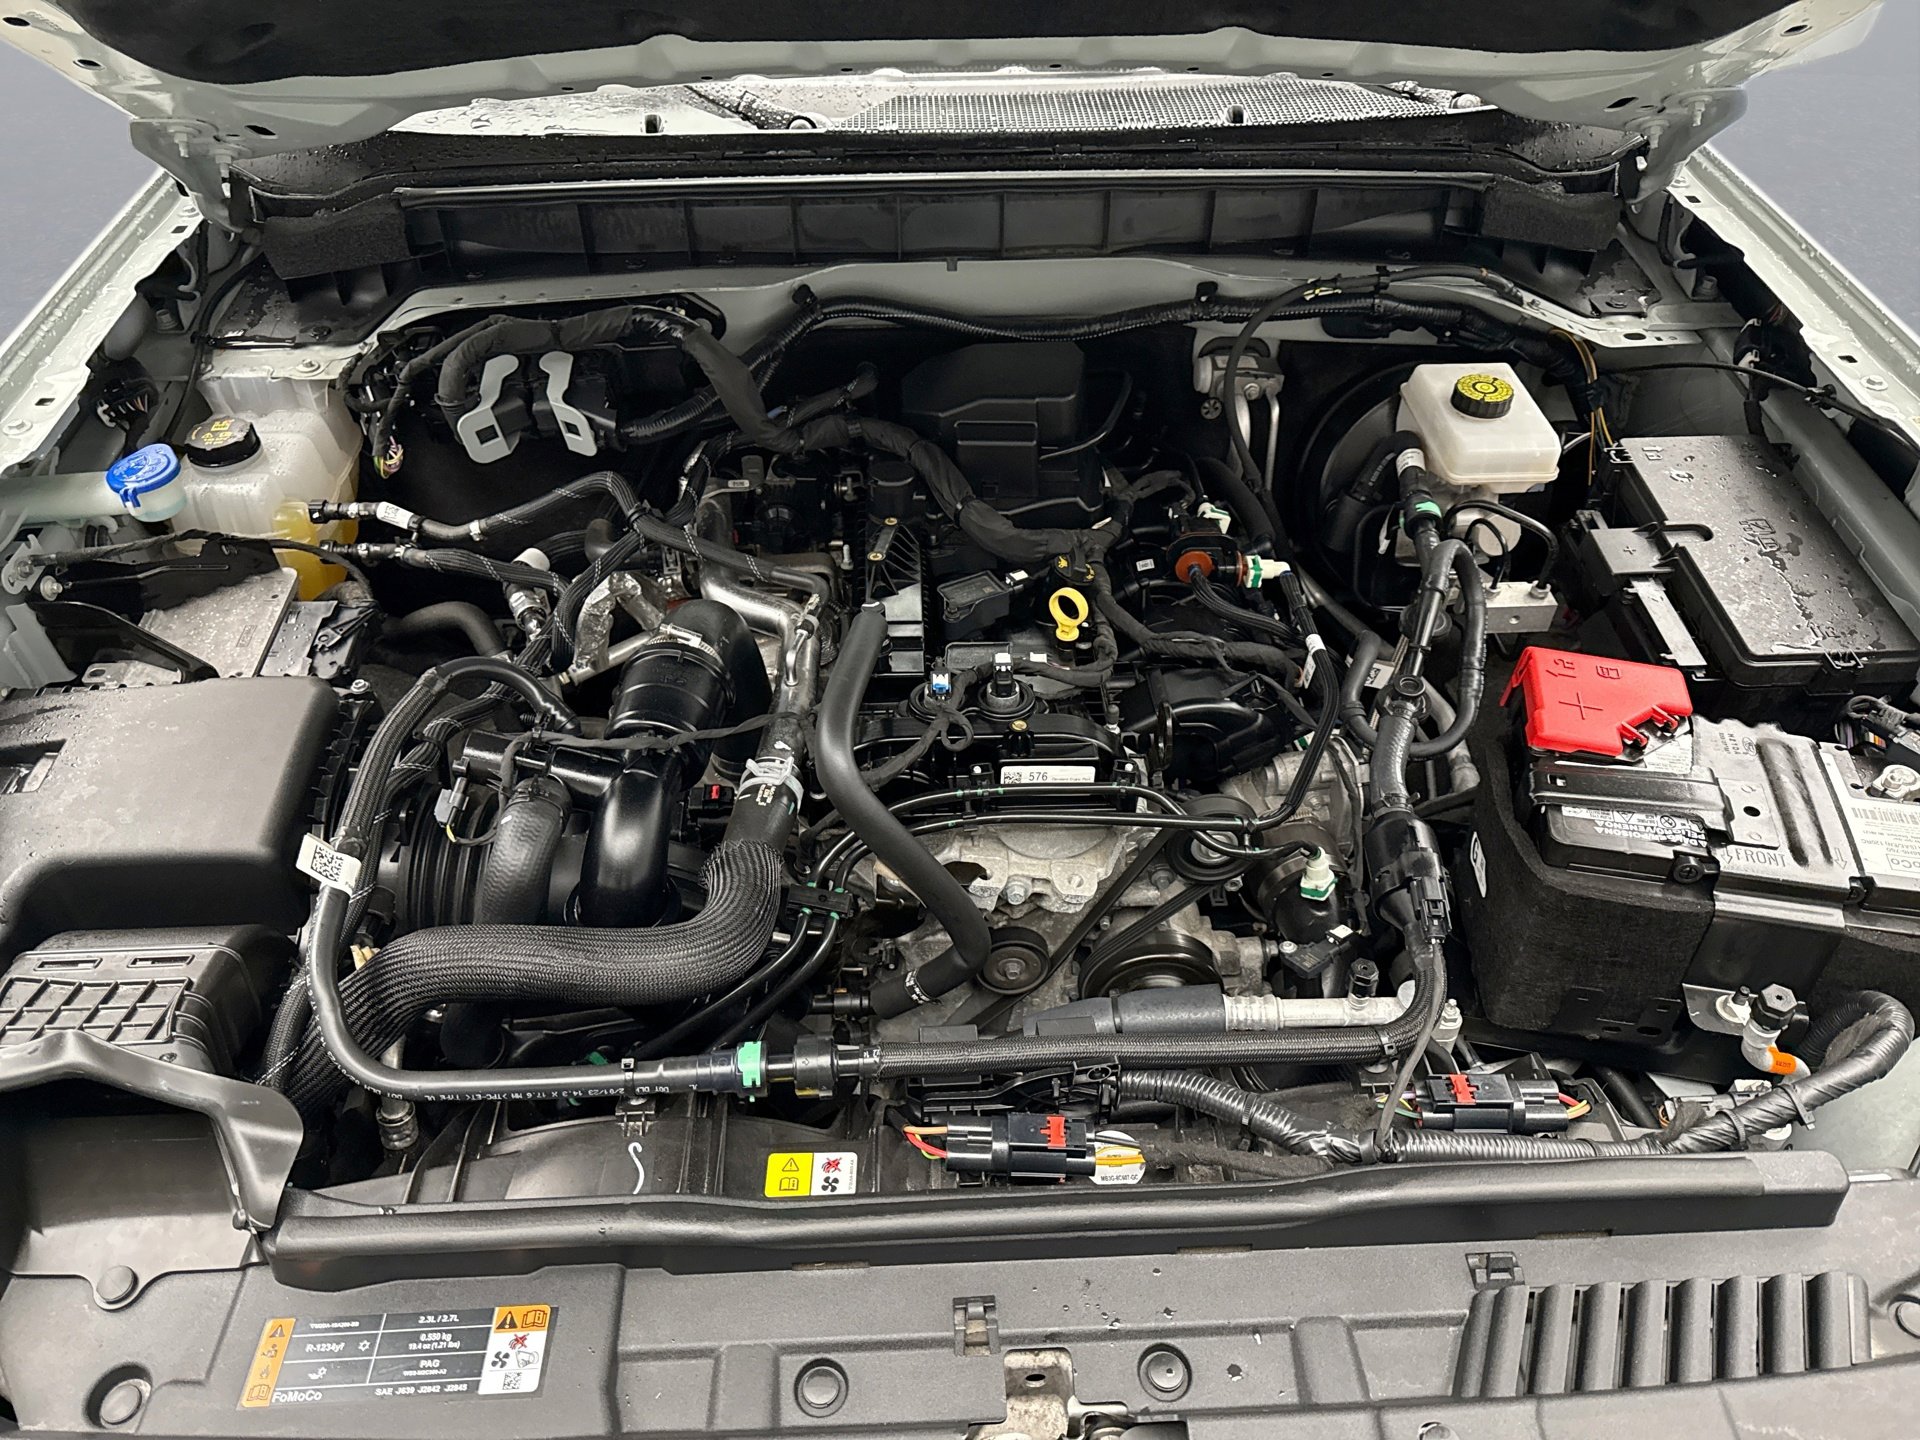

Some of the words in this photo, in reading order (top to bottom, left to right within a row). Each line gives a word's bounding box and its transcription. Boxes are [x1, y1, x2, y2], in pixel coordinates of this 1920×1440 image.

[1028, 771, 1048, 781] 576
[1735, 849, 1787, 868] FRONT
[562, 1089, 583, 1097] 14.3
[588, 1088, 625, 1096] 2/01/23
[418, 1315, 437, 1324] 2.3L
[442, 1314, 460, 1323] 2.7L
[442, 1332, 452, 1342] kg
[305, 1342, 345, 1353] R-1234yf
[419, 1359, 440, 1368] PAG
[374, 1388, 394, 1396] SAE
[395, 1386, 416, 1395] J639
[271, 1390, 323, 1403] FoMoCo
